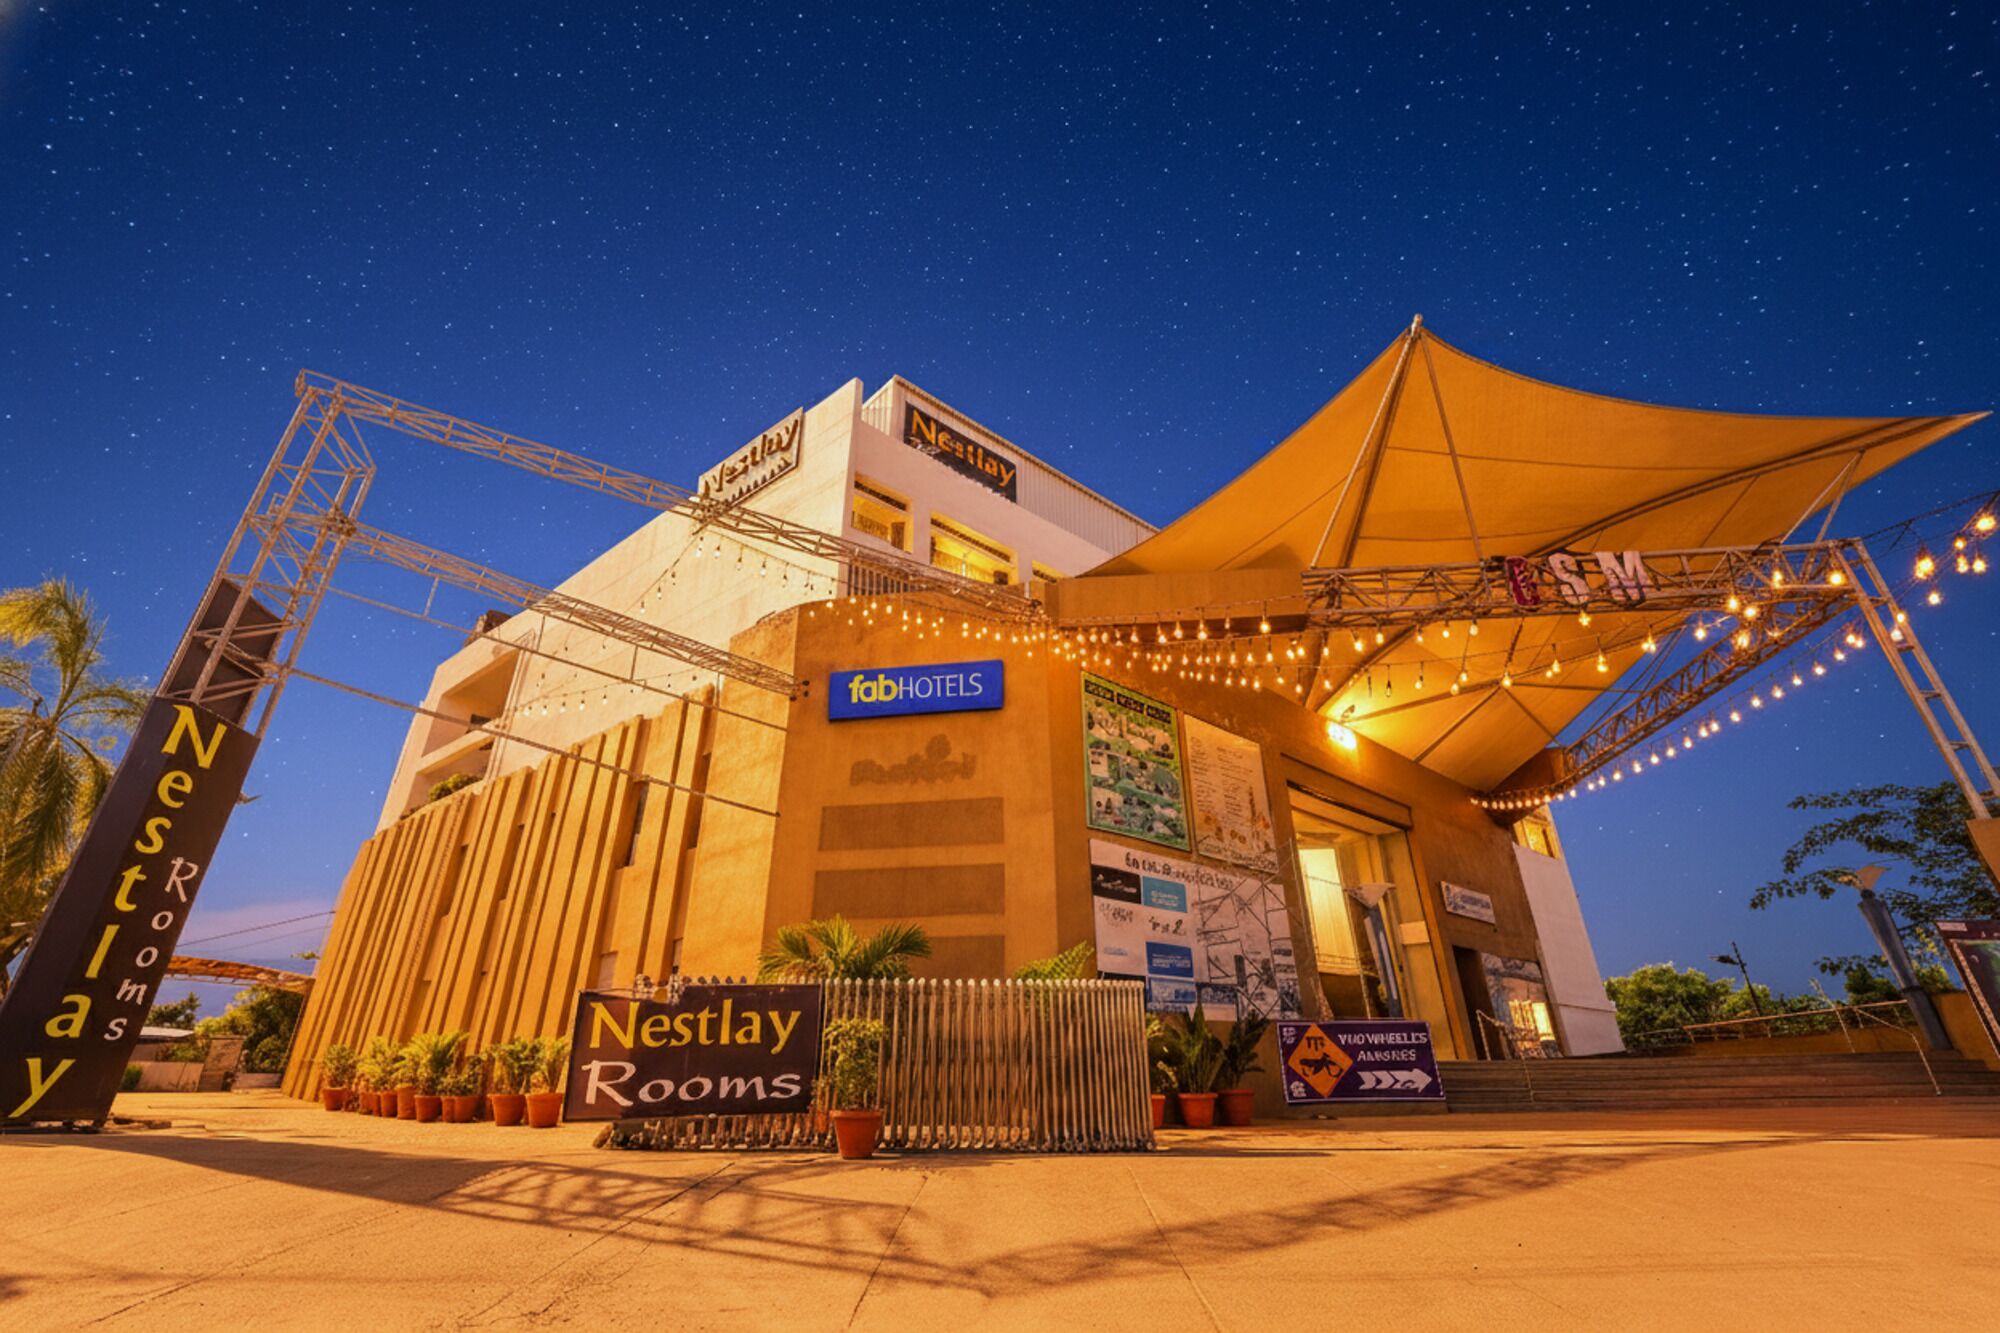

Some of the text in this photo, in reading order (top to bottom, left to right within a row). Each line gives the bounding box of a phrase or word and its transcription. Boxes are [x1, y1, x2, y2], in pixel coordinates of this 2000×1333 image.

[848, 672, 983, 703] fabHOTELS
[8, 704, 228, 1118] Nestlay
[104, 856, 199, 1041] Rooms
[589, 998, 801, 1055] Nestlay
[581, 1060, 801, 1107] Rooms
